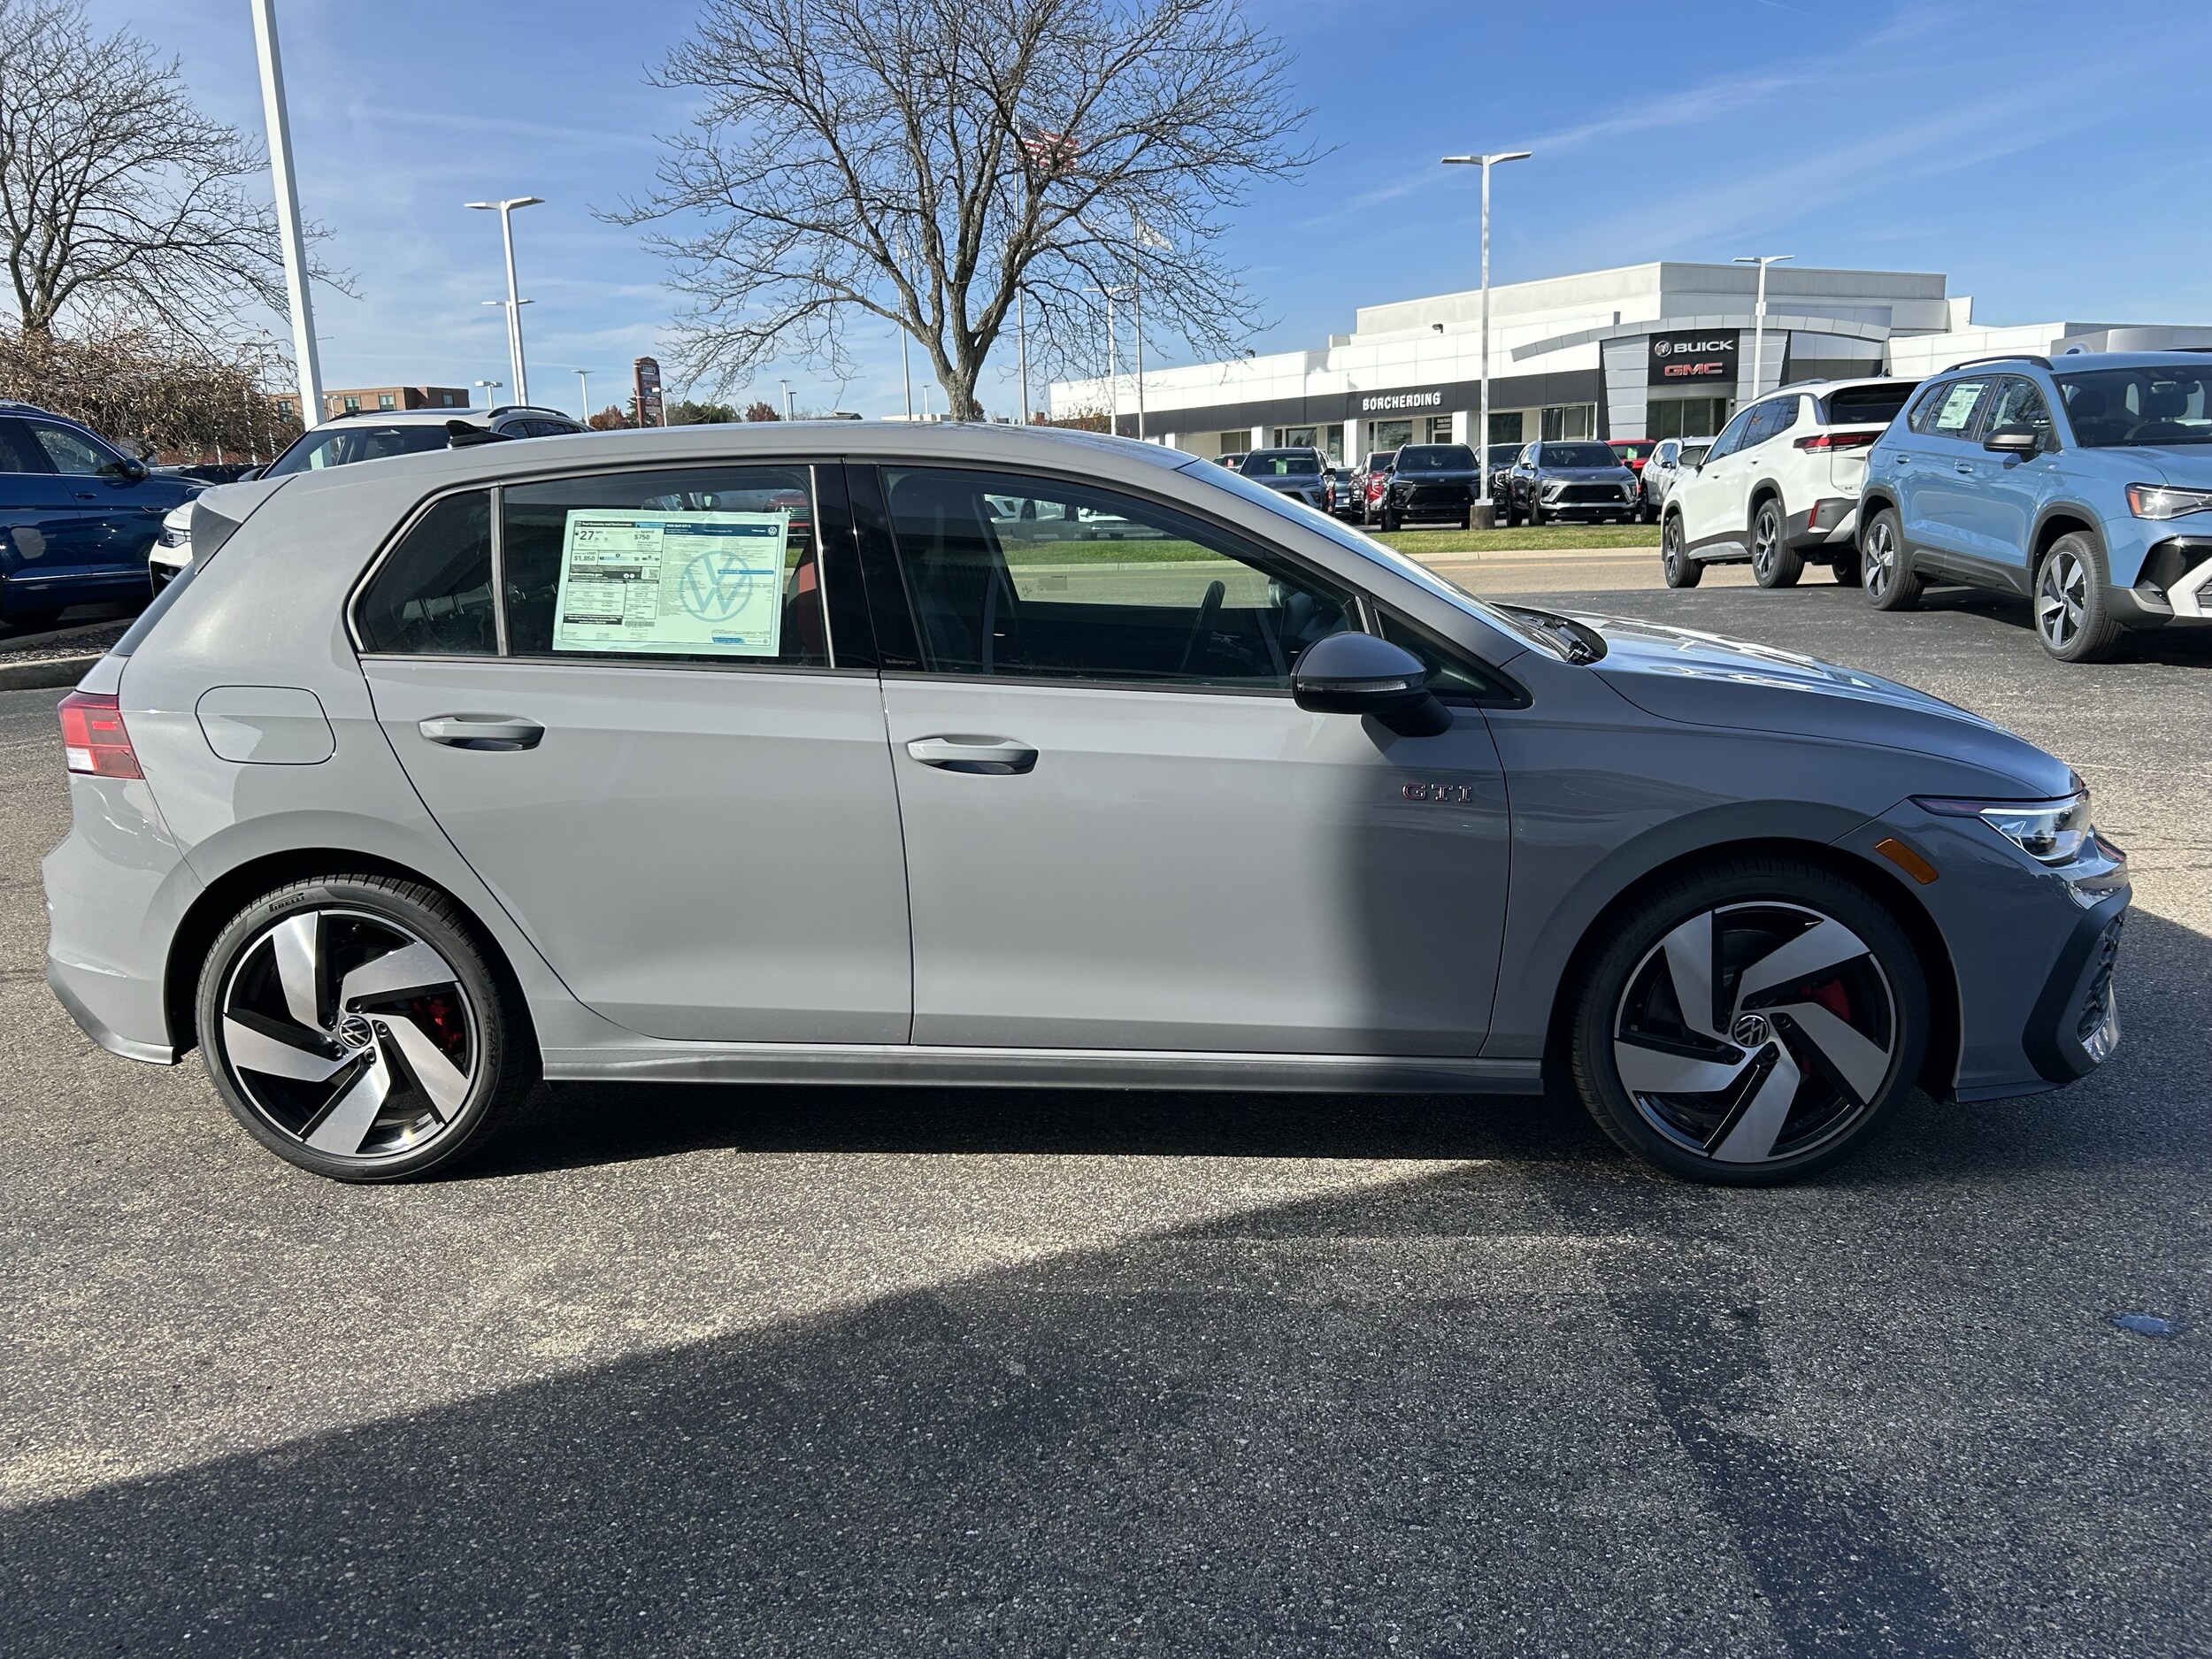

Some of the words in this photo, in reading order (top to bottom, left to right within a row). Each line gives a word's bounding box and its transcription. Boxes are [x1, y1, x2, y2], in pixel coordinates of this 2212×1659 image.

[1674, 340, 1733, 353] BUICK
[1664, 363, 1723, 377] GMC
[1363, 392, 1440, 411] BORCHERDING
[580, 531, 594, 540] 27
[1402, 783, 1472, 803] GTI
[269, 892, 304, 912] PIRELLI
